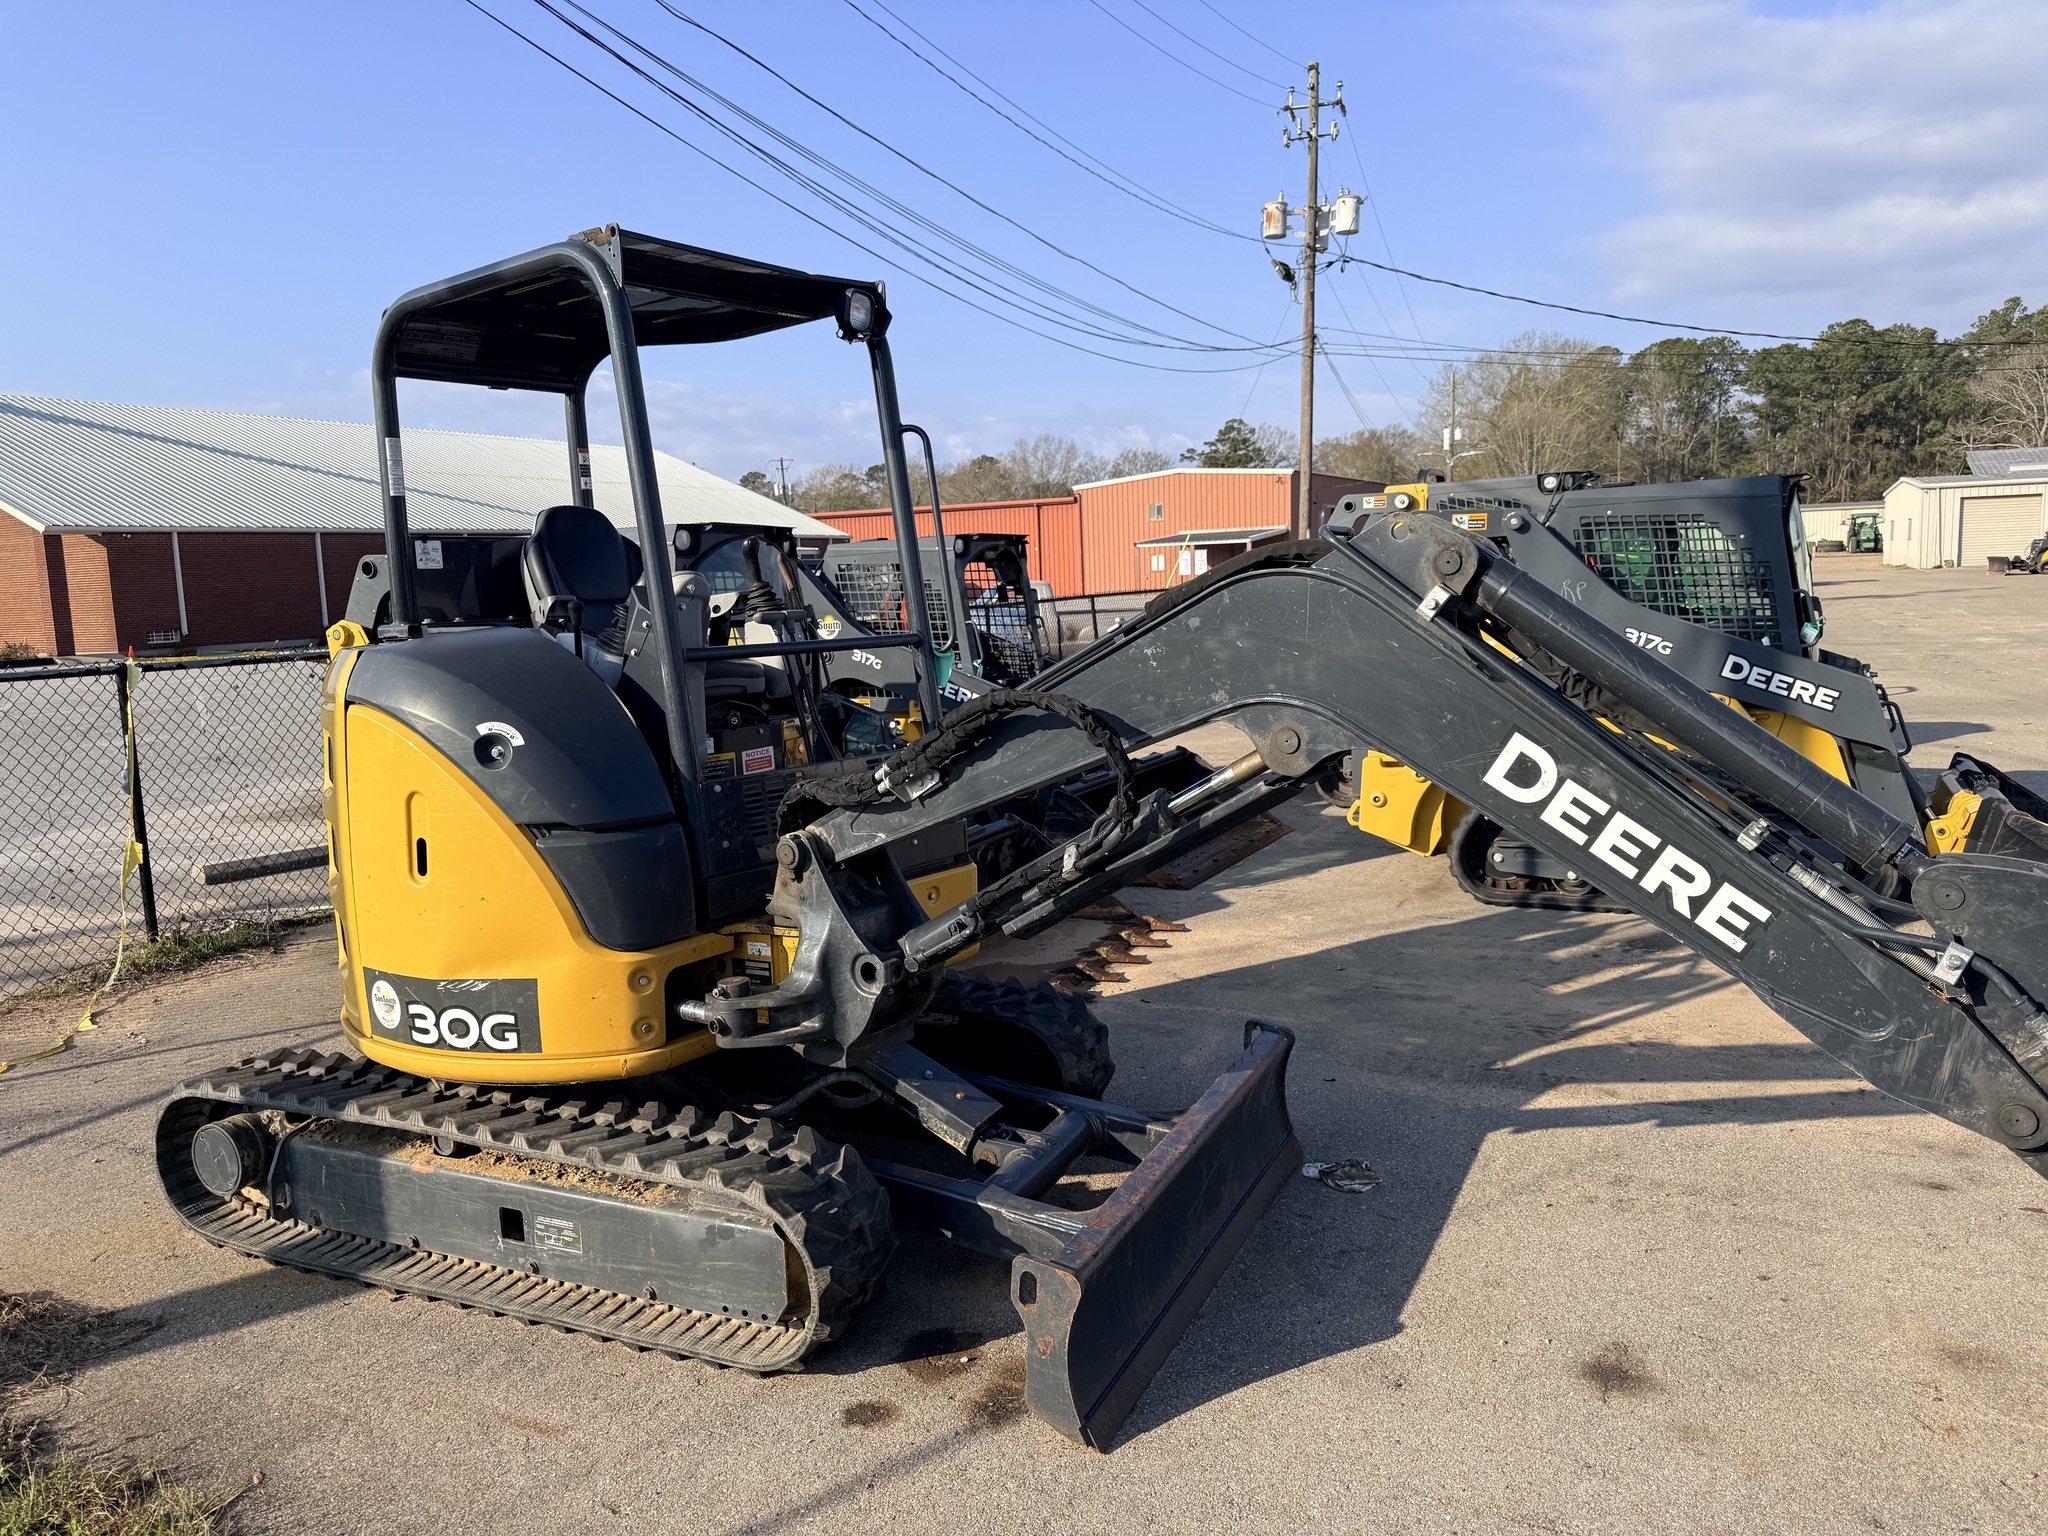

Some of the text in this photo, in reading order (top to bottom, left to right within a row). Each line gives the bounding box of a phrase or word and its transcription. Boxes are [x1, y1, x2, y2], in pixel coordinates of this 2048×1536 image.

[851, 648, 883, 670] 317G
[1624, 627, 1674, 655] 317G
[1720, 653, 1840, 711] DEERE
[745, 748, 771, 758] NOTICE
[1483, 731, 1772, 953] DEERE
[407, 1003, 520, 1050] 30G
